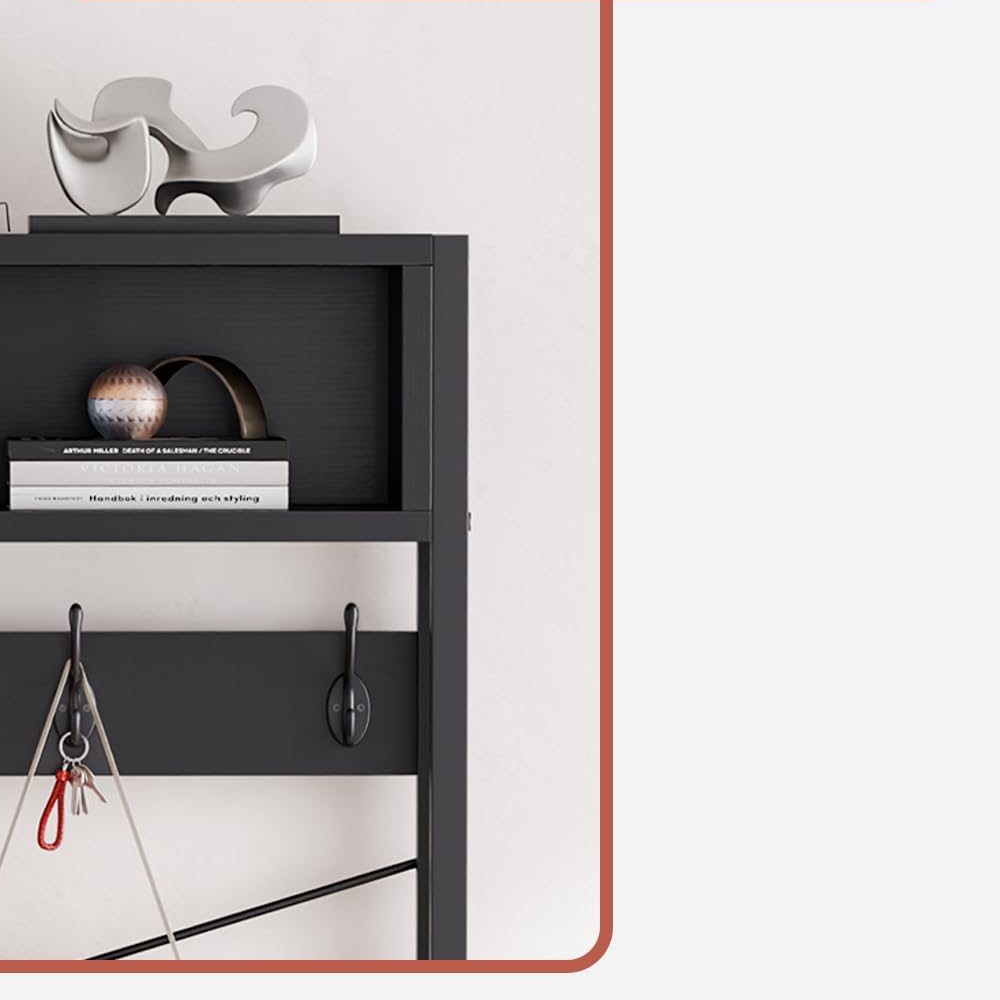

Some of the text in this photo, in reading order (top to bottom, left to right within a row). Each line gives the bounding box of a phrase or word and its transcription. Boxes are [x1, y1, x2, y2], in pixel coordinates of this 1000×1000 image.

[62, 447, 92, 455] ARTHUR
[93, 447, 119, 455] MILLER
[122, 447, 145, 455] DEATH
[145, 447, 155, 455] OF
[162, 447, 198, 455] SALESMAN
[203, 447, 217, 455] THE
[217, 447, 252, 455] CRUCIBLE
[80, 463, 240, 473] VICTORIA HAGAN
[89, 494, 137, 502] Handbok
[146, 494, 198, 504] inredning
[223, 495, 260, 504] styling
